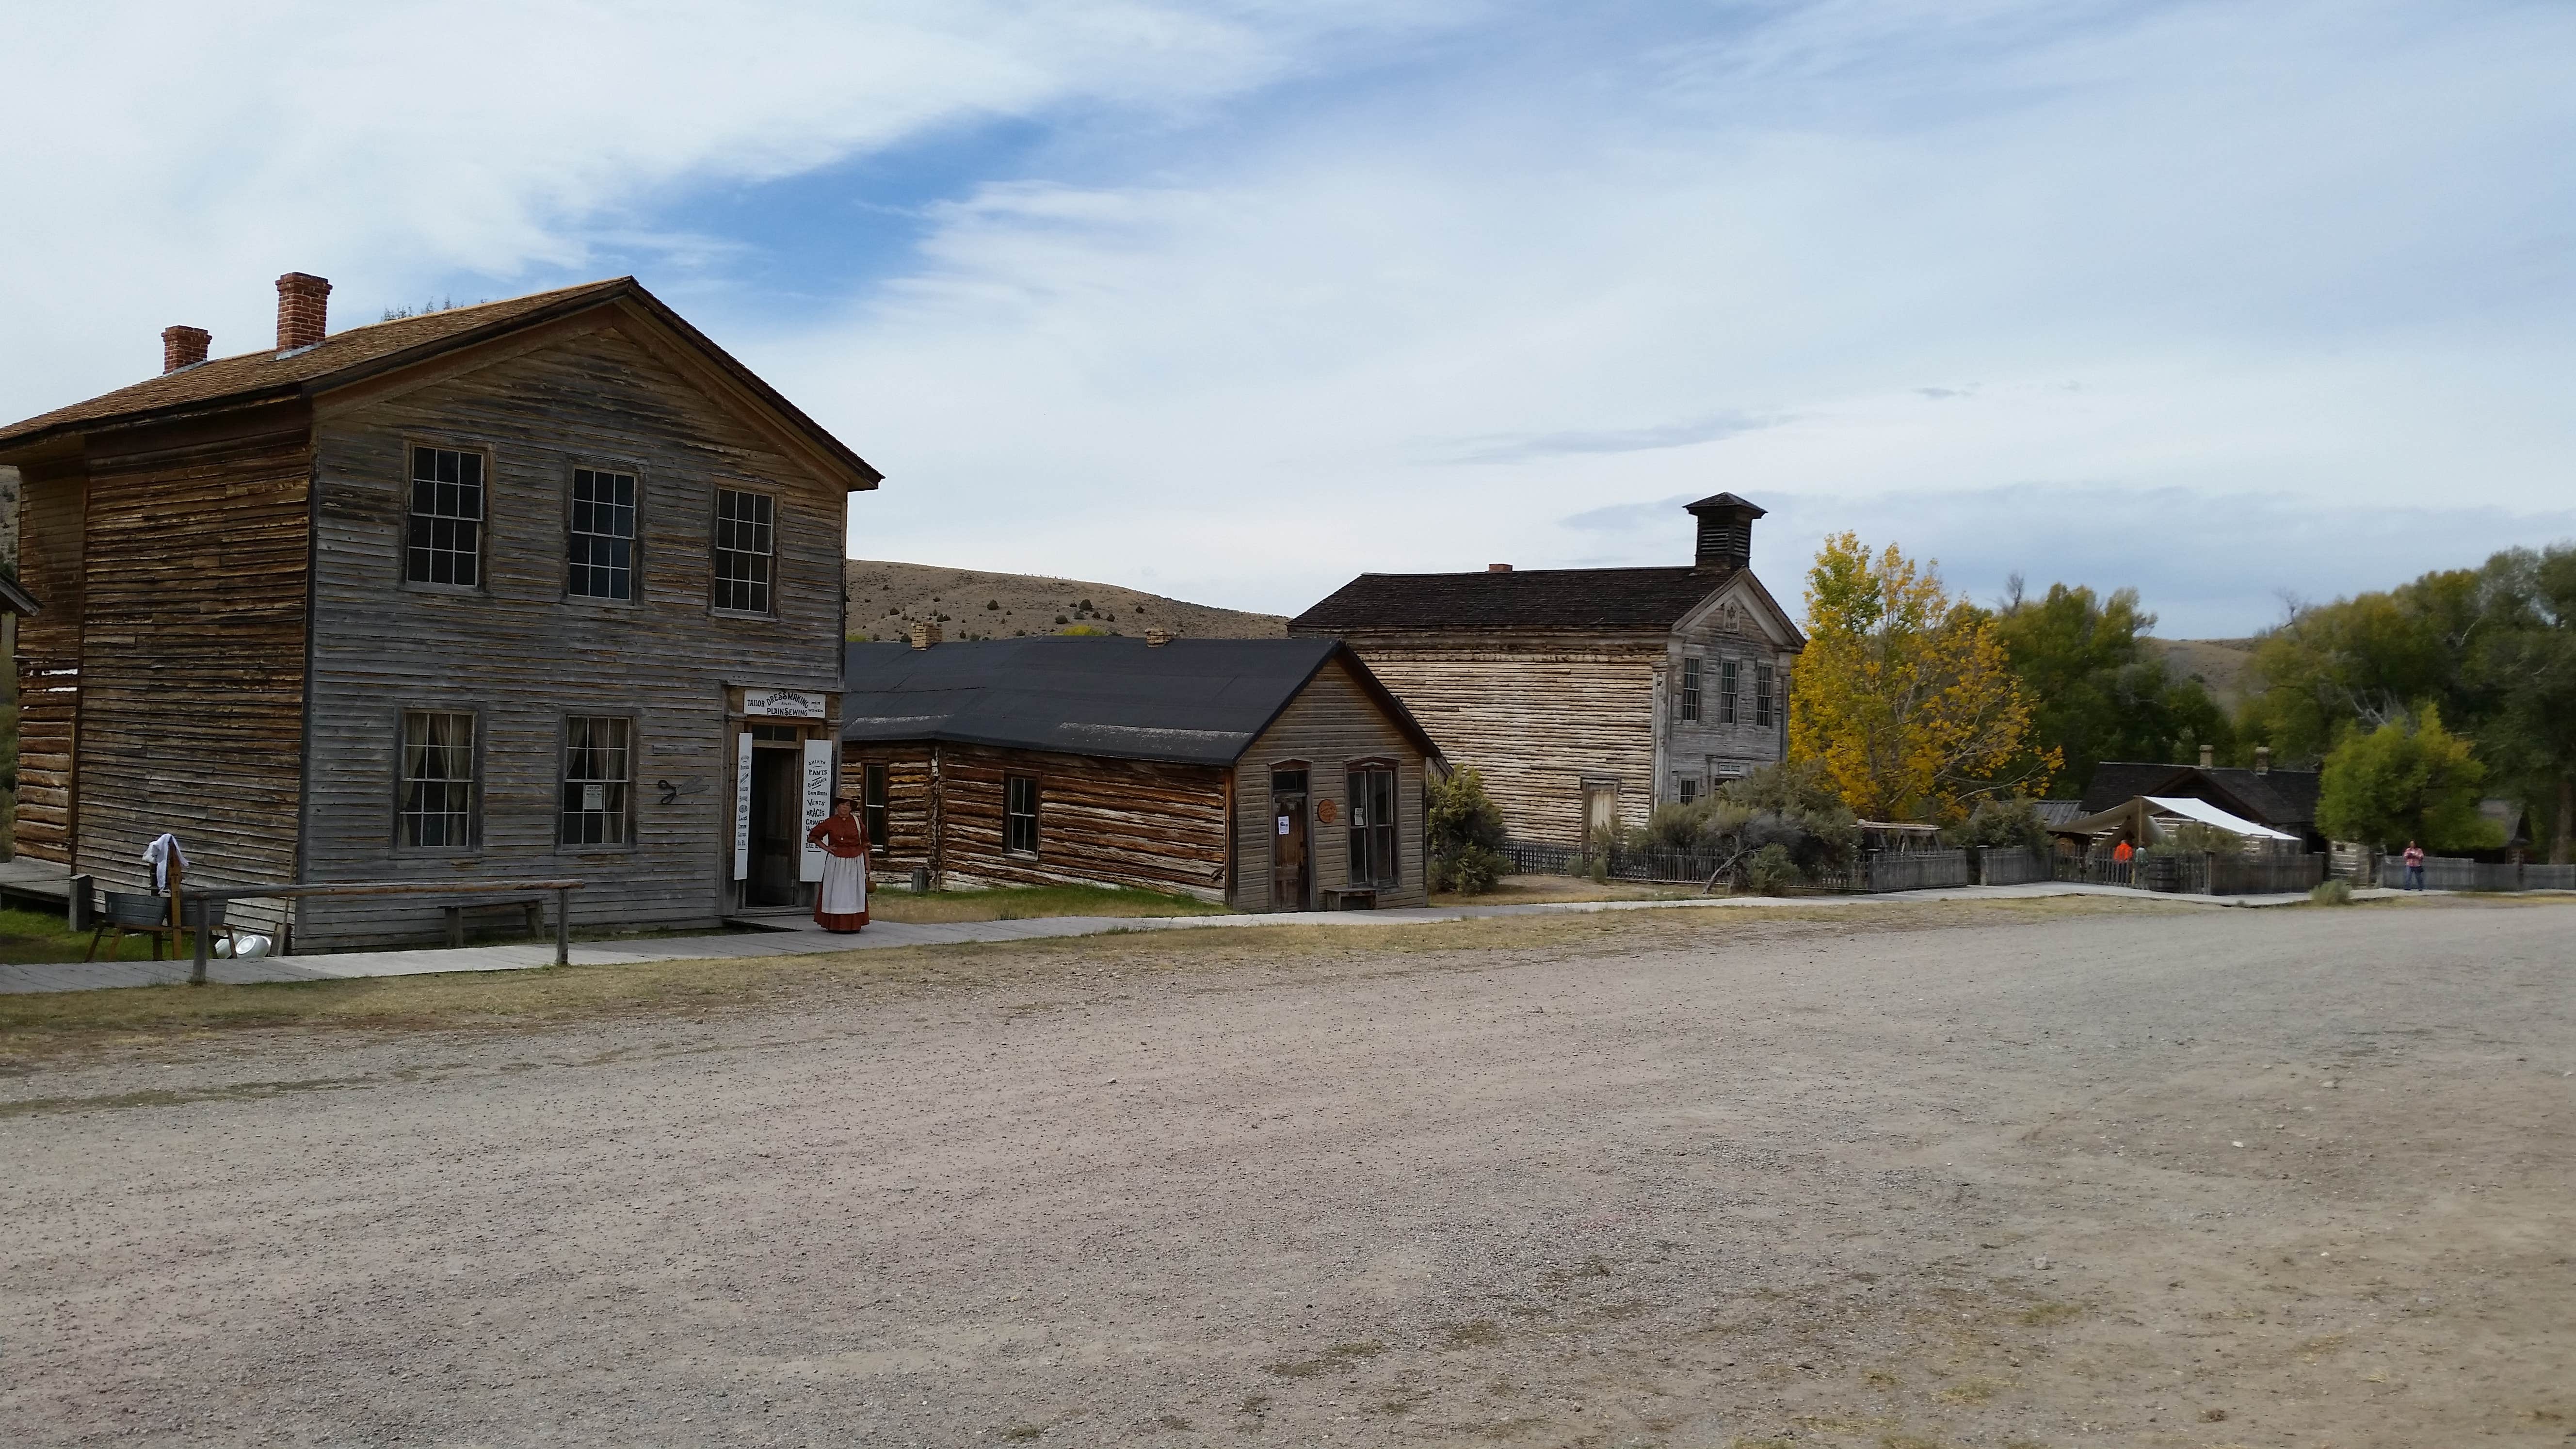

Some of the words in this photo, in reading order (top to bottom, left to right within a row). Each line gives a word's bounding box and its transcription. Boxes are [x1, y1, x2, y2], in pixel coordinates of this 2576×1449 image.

[766, 692, 808, 708] DRESSMAKING
[785, 708, 808, 716] SEWING
[806, 808, 825, 817] BRACES
